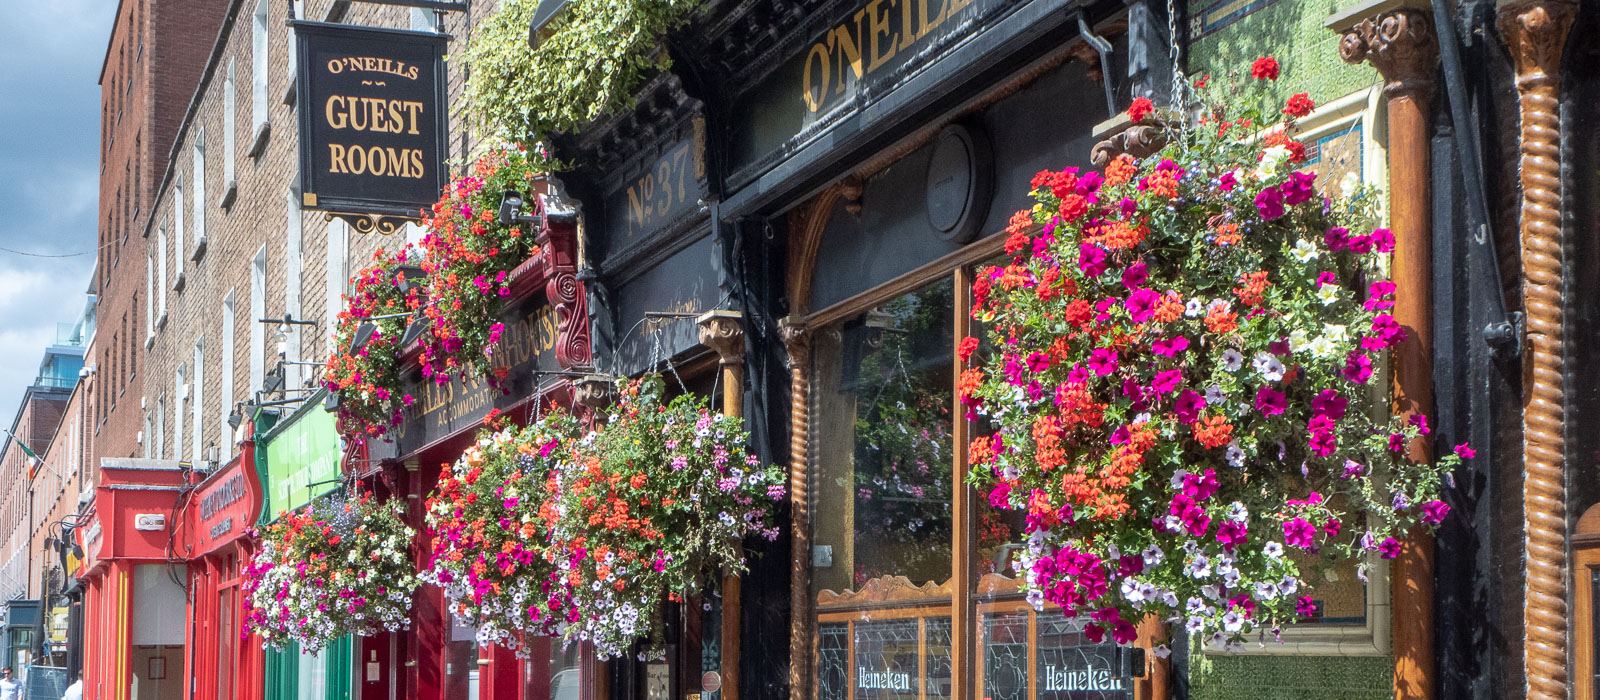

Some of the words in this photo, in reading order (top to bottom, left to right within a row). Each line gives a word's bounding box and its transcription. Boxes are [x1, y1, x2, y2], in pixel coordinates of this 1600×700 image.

[327, 57, 419, 80] O'NEILLS
[802, 0, 974, 112] O'NEIL
[325, 94, 424, 135] GUEST
[328, 143, 425, 179] ROOMS
[657, 144, 689, 217] 37
[453, 303, 563, 396] TONHOUS
[858, 666, 910, 690] Heineken
